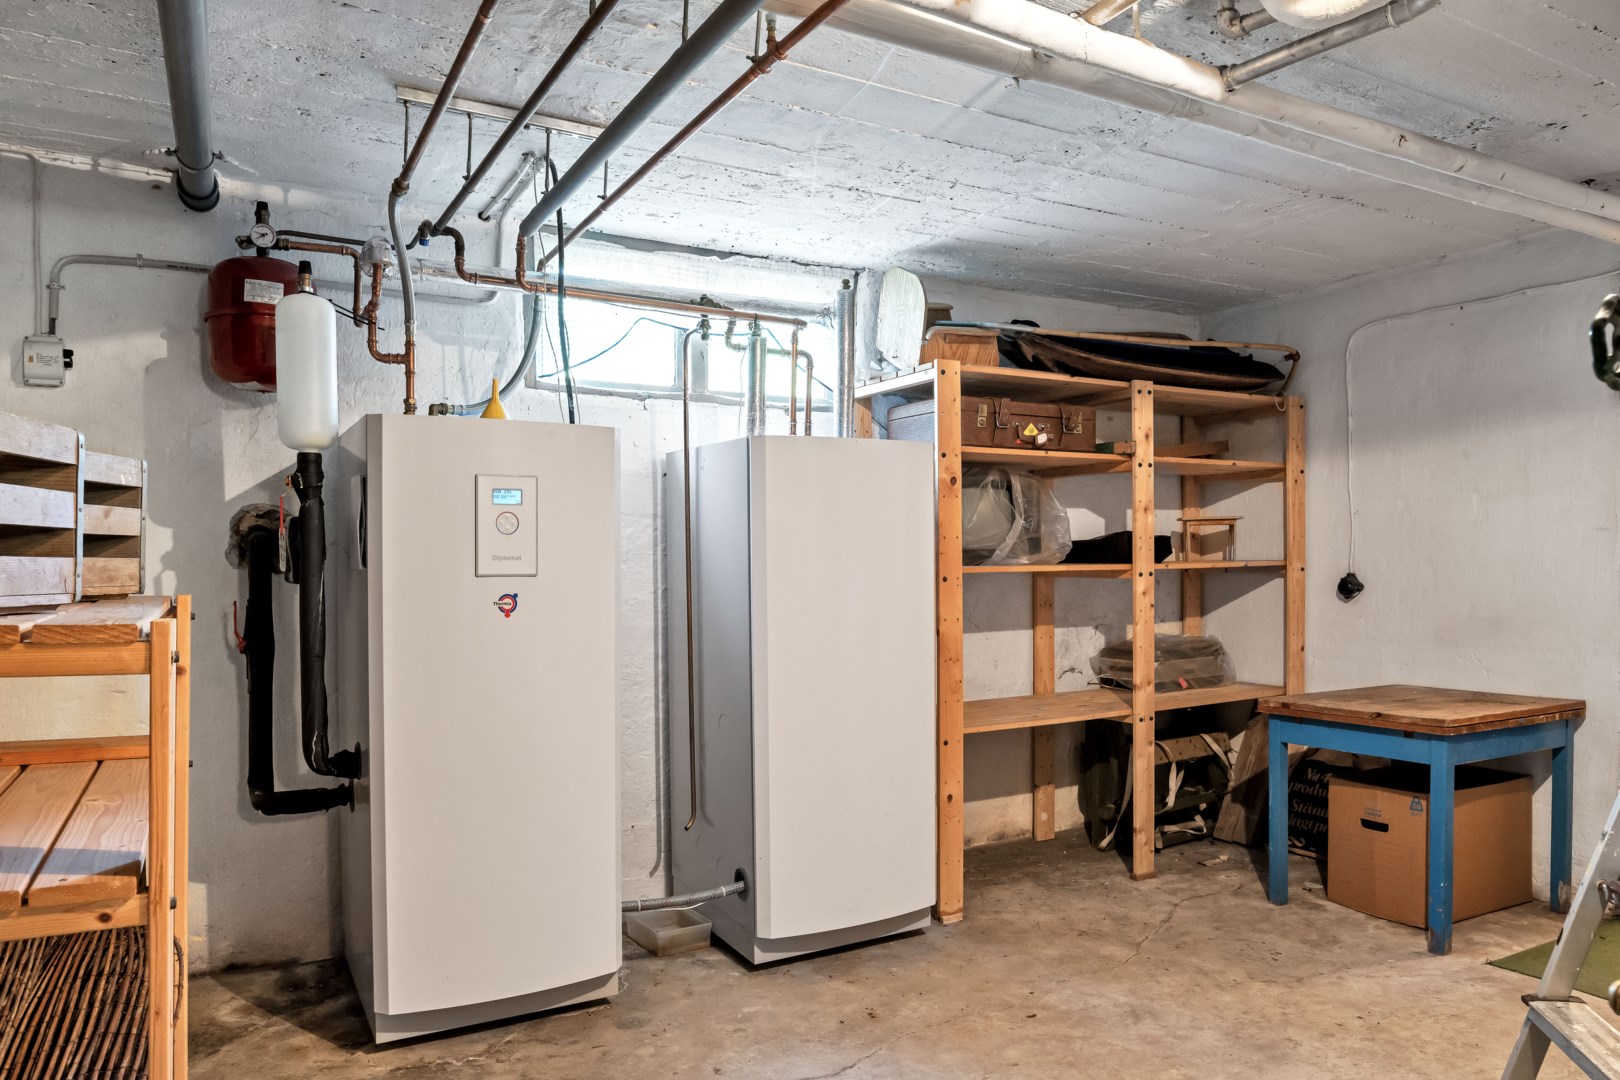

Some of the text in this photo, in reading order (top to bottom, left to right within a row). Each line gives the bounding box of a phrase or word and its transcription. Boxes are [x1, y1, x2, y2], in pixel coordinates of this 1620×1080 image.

[492, 554, 522, 562] Diplomat
[1303, 767, 1321, 782] Nu
[1288, 782, 1328, 798] produ
[1312, 822, 1328, 834] pr
